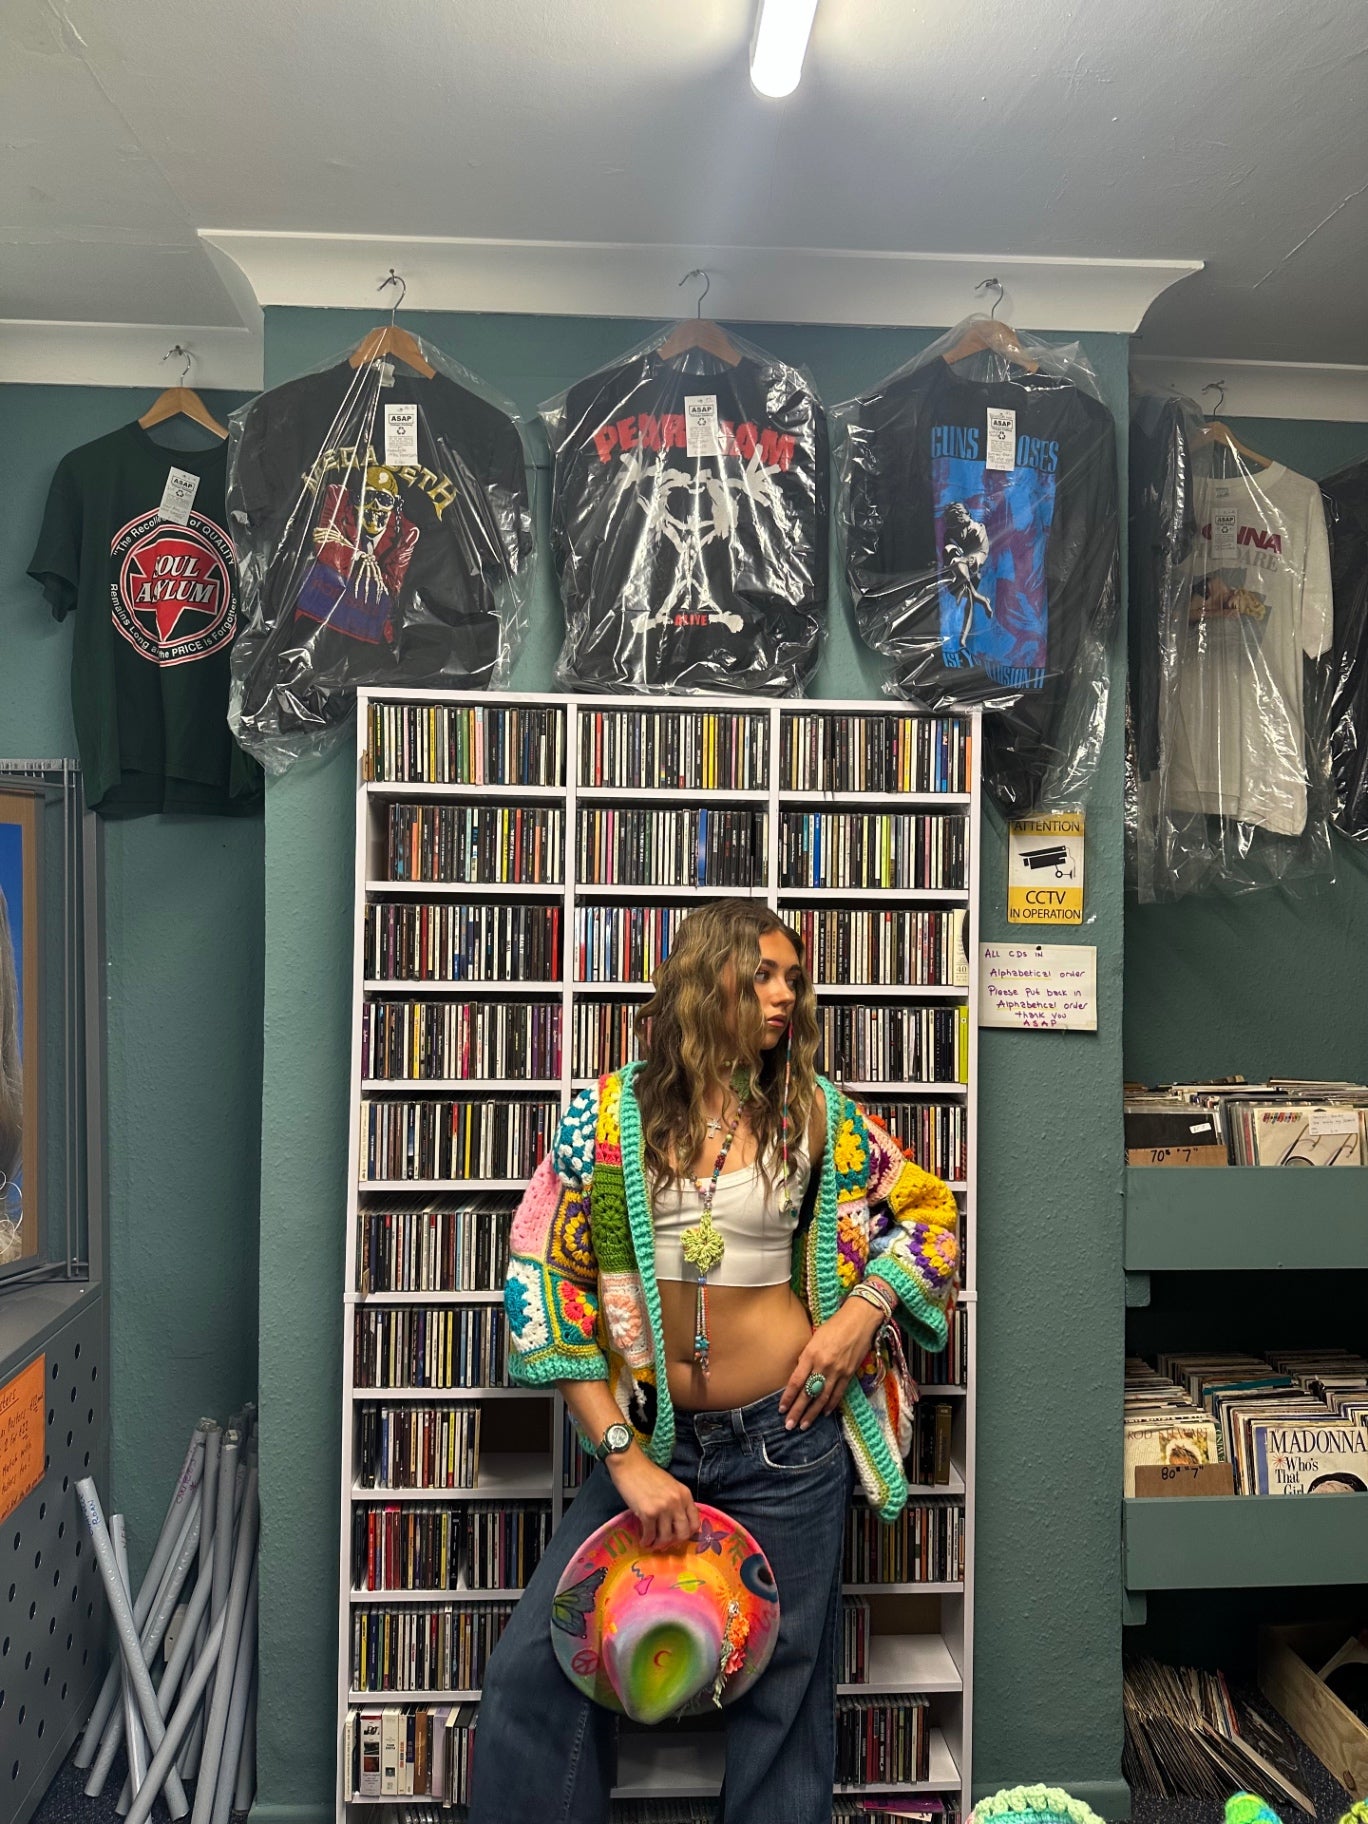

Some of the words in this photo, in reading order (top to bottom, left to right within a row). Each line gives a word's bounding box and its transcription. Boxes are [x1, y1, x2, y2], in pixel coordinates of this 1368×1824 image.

[691, 406, 712, 414] ASAP
[593, 412, 687, 464] PEAR
[931, 425, 979, 460] GUNS
[1017, 435, 1059, 473] OSES
[173, 478, 194, 489] ASAP
[189, 520, 202, 530] of
[202, 526, 235, 565] QUALITY
[110, 583, 130, 626] Remains
[129, 626, 150, 650] Long
[171, 641, 204, 658] PRICE
[1014, 821, 1080, 832] ATTENTION
[1025, 890, 1067, 905] CCTV
[1010, 908, 1020, 918] IN
[1022, 908, 1081, 920] OPERATION
[984, 949, 1000, 958] ALL
[990, 968, 1052, 979] Alphabetical
[1059, 970, 1086, 978] order
[988, 985, 1019, 997] Please
[1046, 988, 1068, 997] back
[1063, 1002, 1089, 1010] order
[1269, 1430, 1368, 1454] MADONNA
[1285, 1456, 1319, 1472] Who's
[1274, 1468, 1300, 1484] That
[1283, 1484, 1305, 1496] Girl
